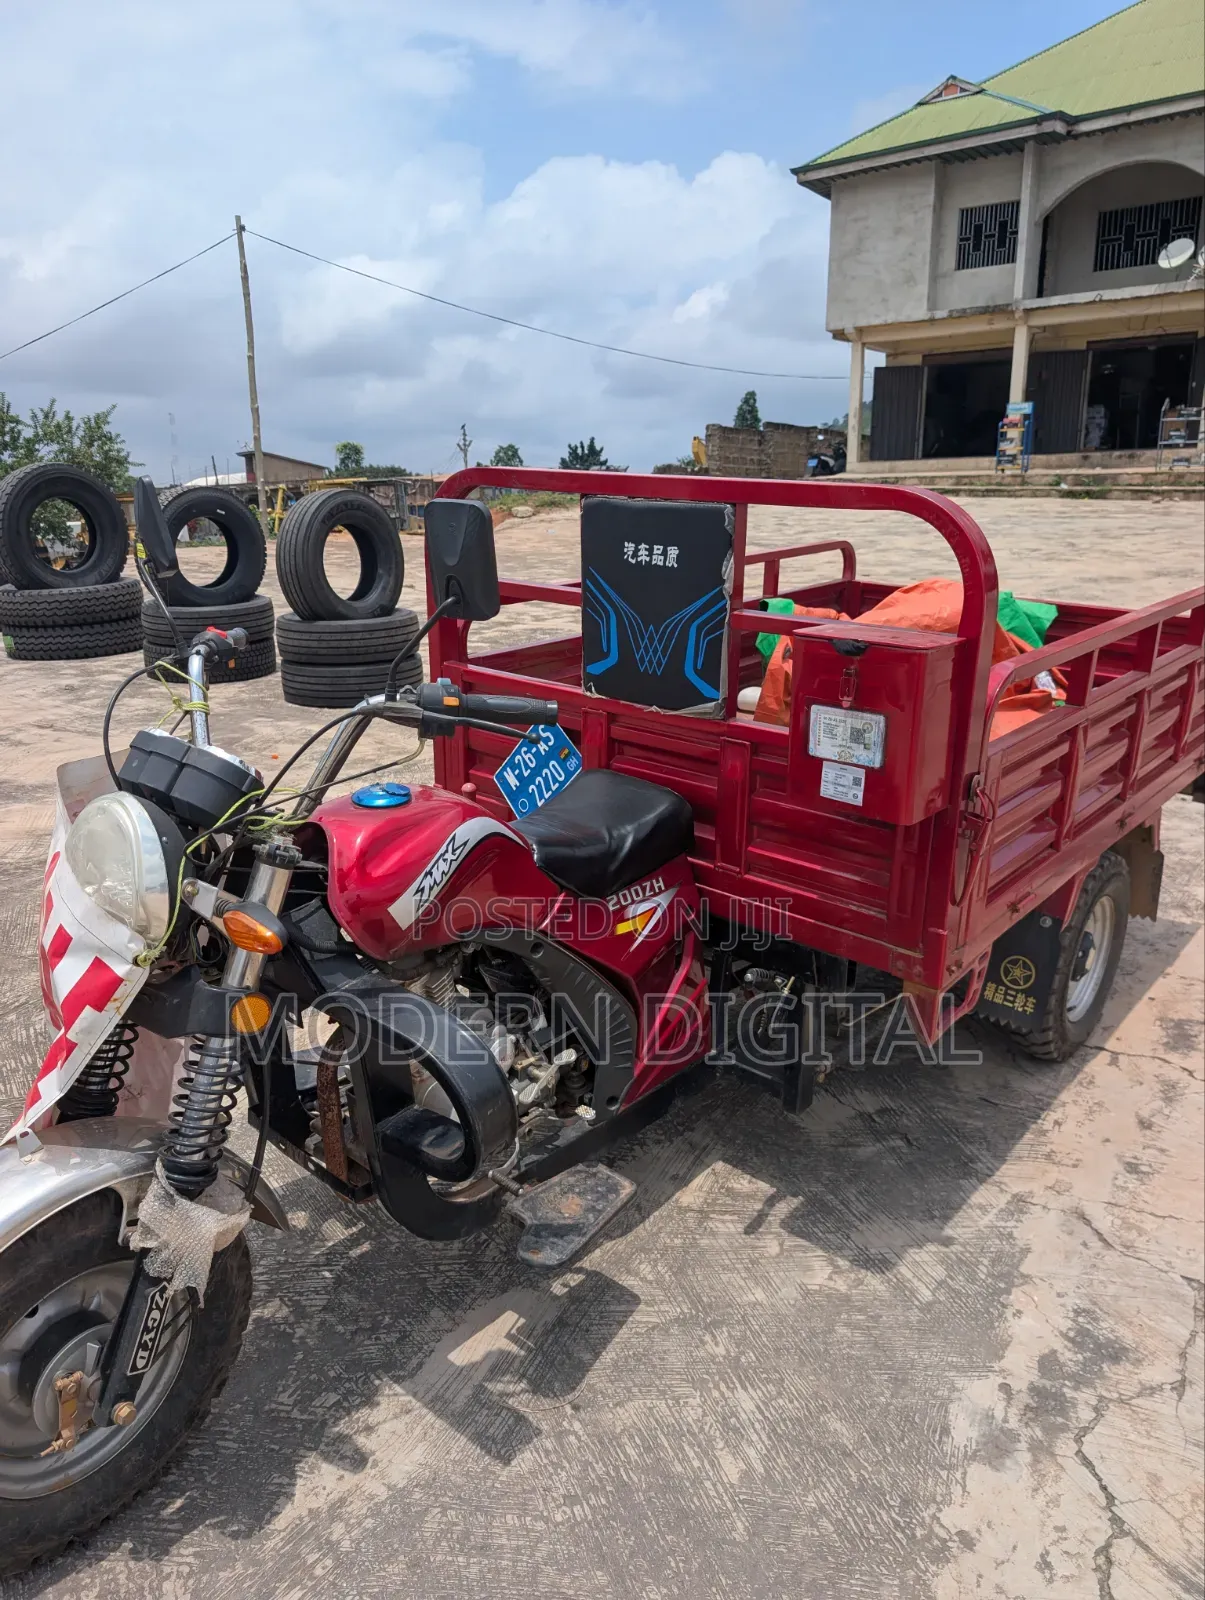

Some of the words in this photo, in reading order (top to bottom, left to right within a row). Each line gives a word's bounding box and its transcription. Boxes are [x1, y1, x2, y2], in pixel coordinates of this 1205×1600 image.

[623, 541, 680, 568] 汽车品质
[566, 755, 579, 771] GH
[528, 760, 565, 807] 2220
[607, 877, 666, 911] 200ZH
[135, 1291, 168, 1369] ZGYD
